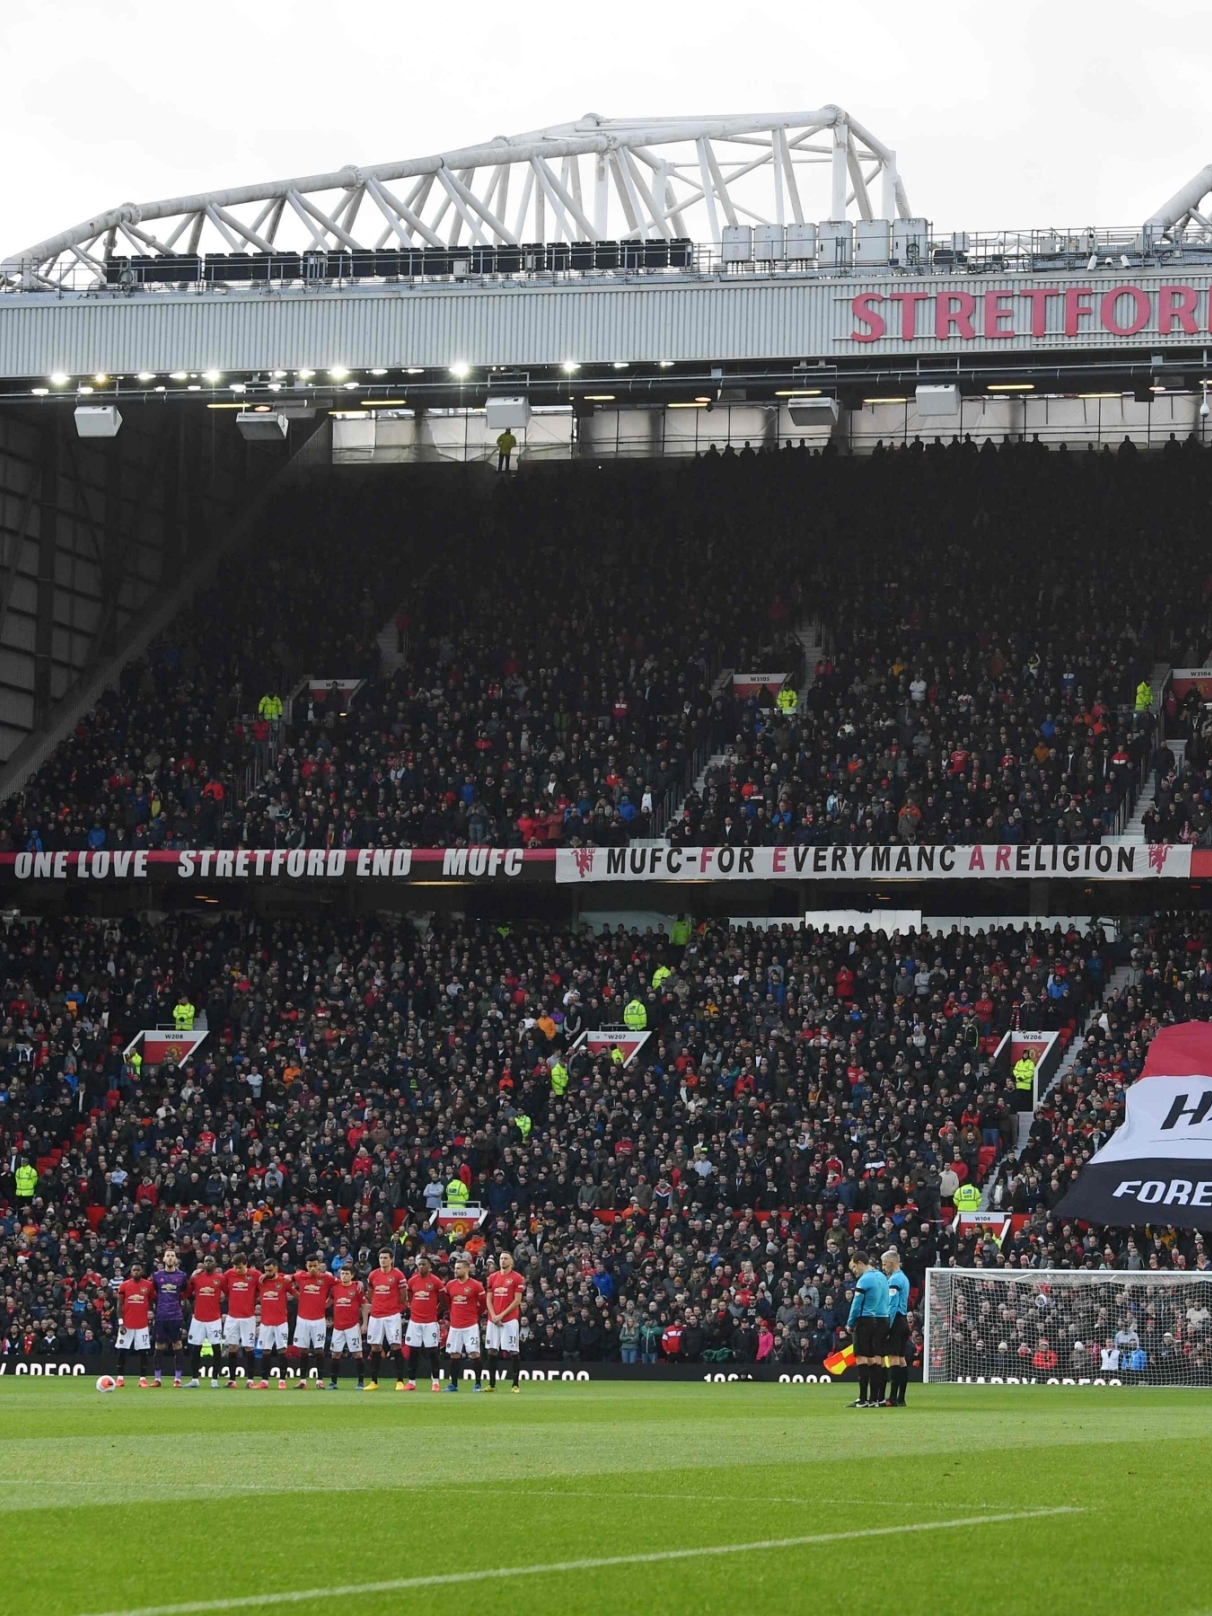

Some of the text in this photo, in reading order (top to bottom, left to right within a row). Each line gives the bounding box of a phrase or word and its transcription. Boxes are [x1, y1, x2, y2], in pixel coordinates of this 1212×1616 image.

[15, 849, 523, 878] ONE LOVE STRETFORD END MUFC
[968, 845, 985, 871] A
[995, 845, 1136, 873] RELIGION
